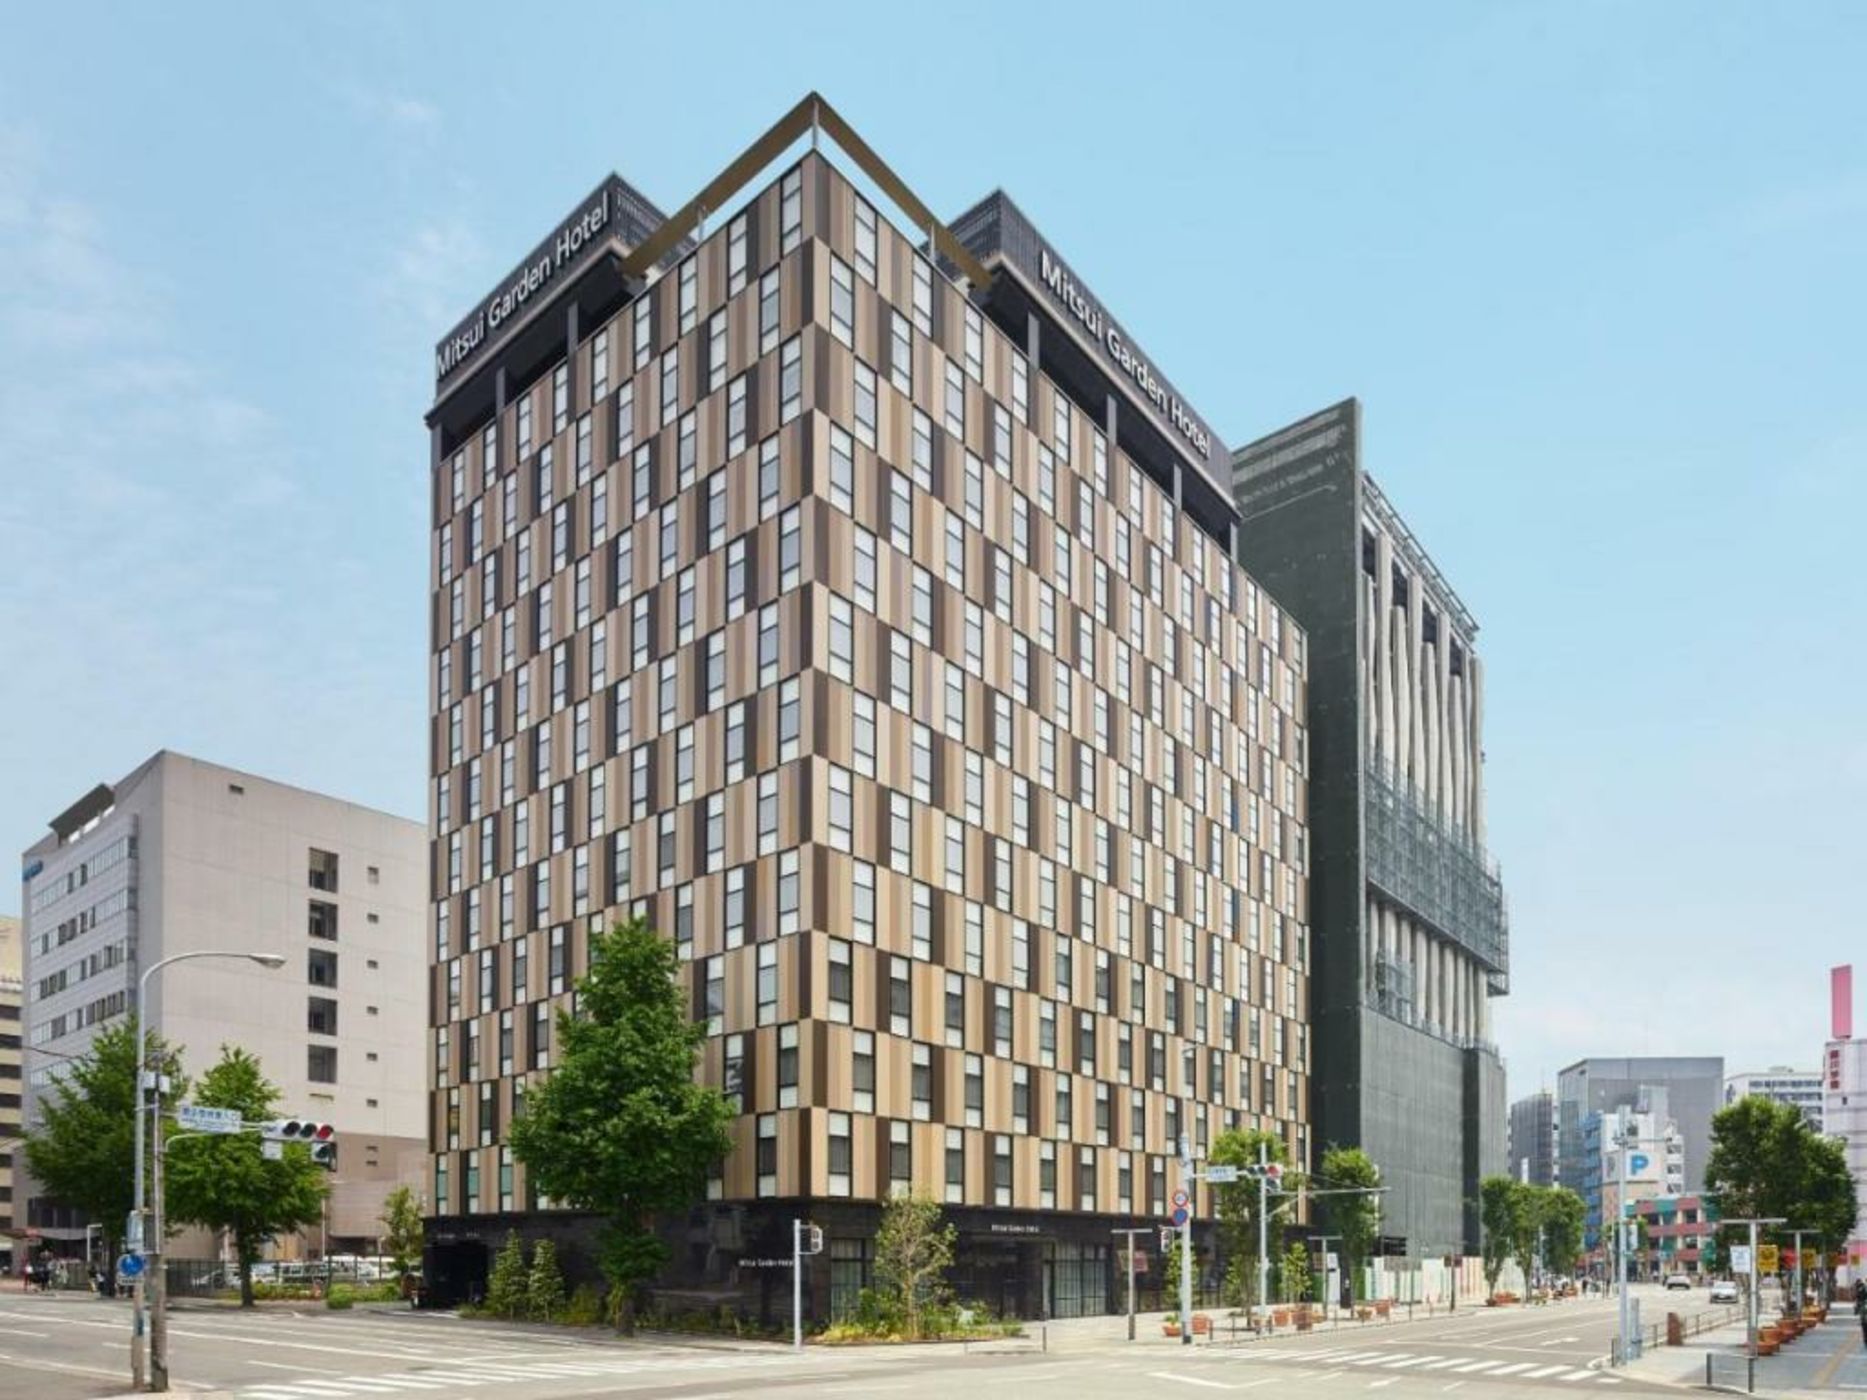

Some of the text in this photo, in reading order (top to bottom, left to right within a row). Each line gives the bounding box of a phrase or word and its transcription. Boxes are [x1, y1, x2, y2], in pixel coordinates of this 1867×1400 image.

[437, 190, 609, 376] Mitsui Garden Hotel
[1041, 249, 1210, 459] Mitsui Garden Hotel
[1630, 1154, 1650, 1176] P
